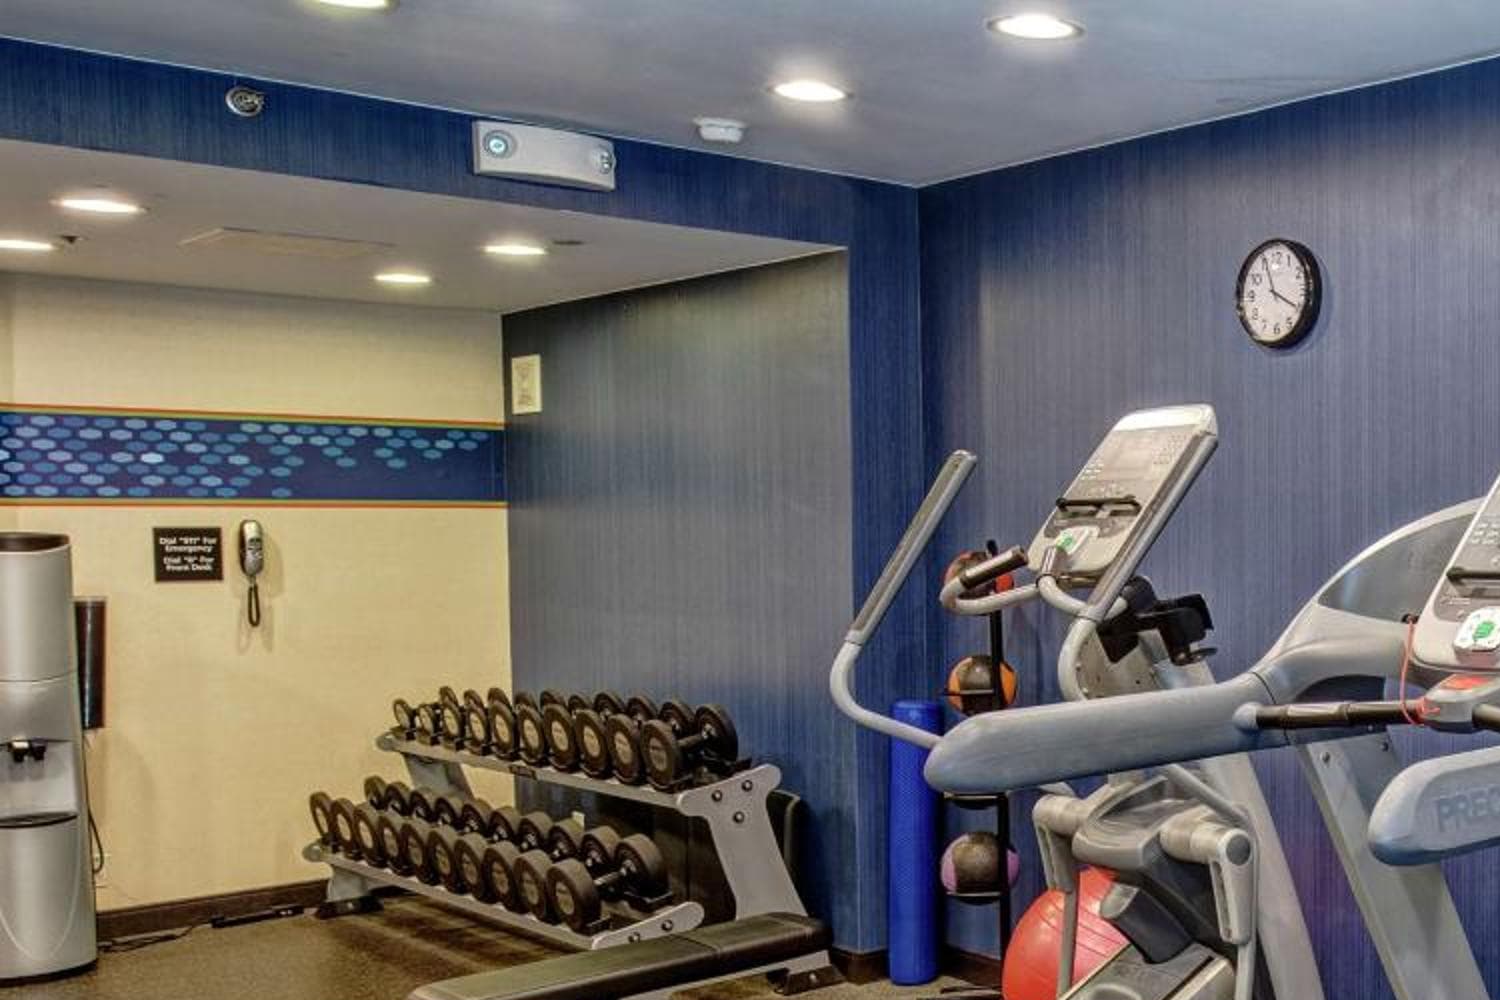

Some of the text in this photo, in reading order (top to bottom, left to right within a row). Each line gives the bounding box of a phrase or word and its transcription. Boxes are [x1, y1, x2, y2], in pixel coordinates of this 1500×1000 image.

[165, 545, 213, 553] Emergency
[163, 556, 181, 564] Dial
[192, 563, 213, 571] Desk
